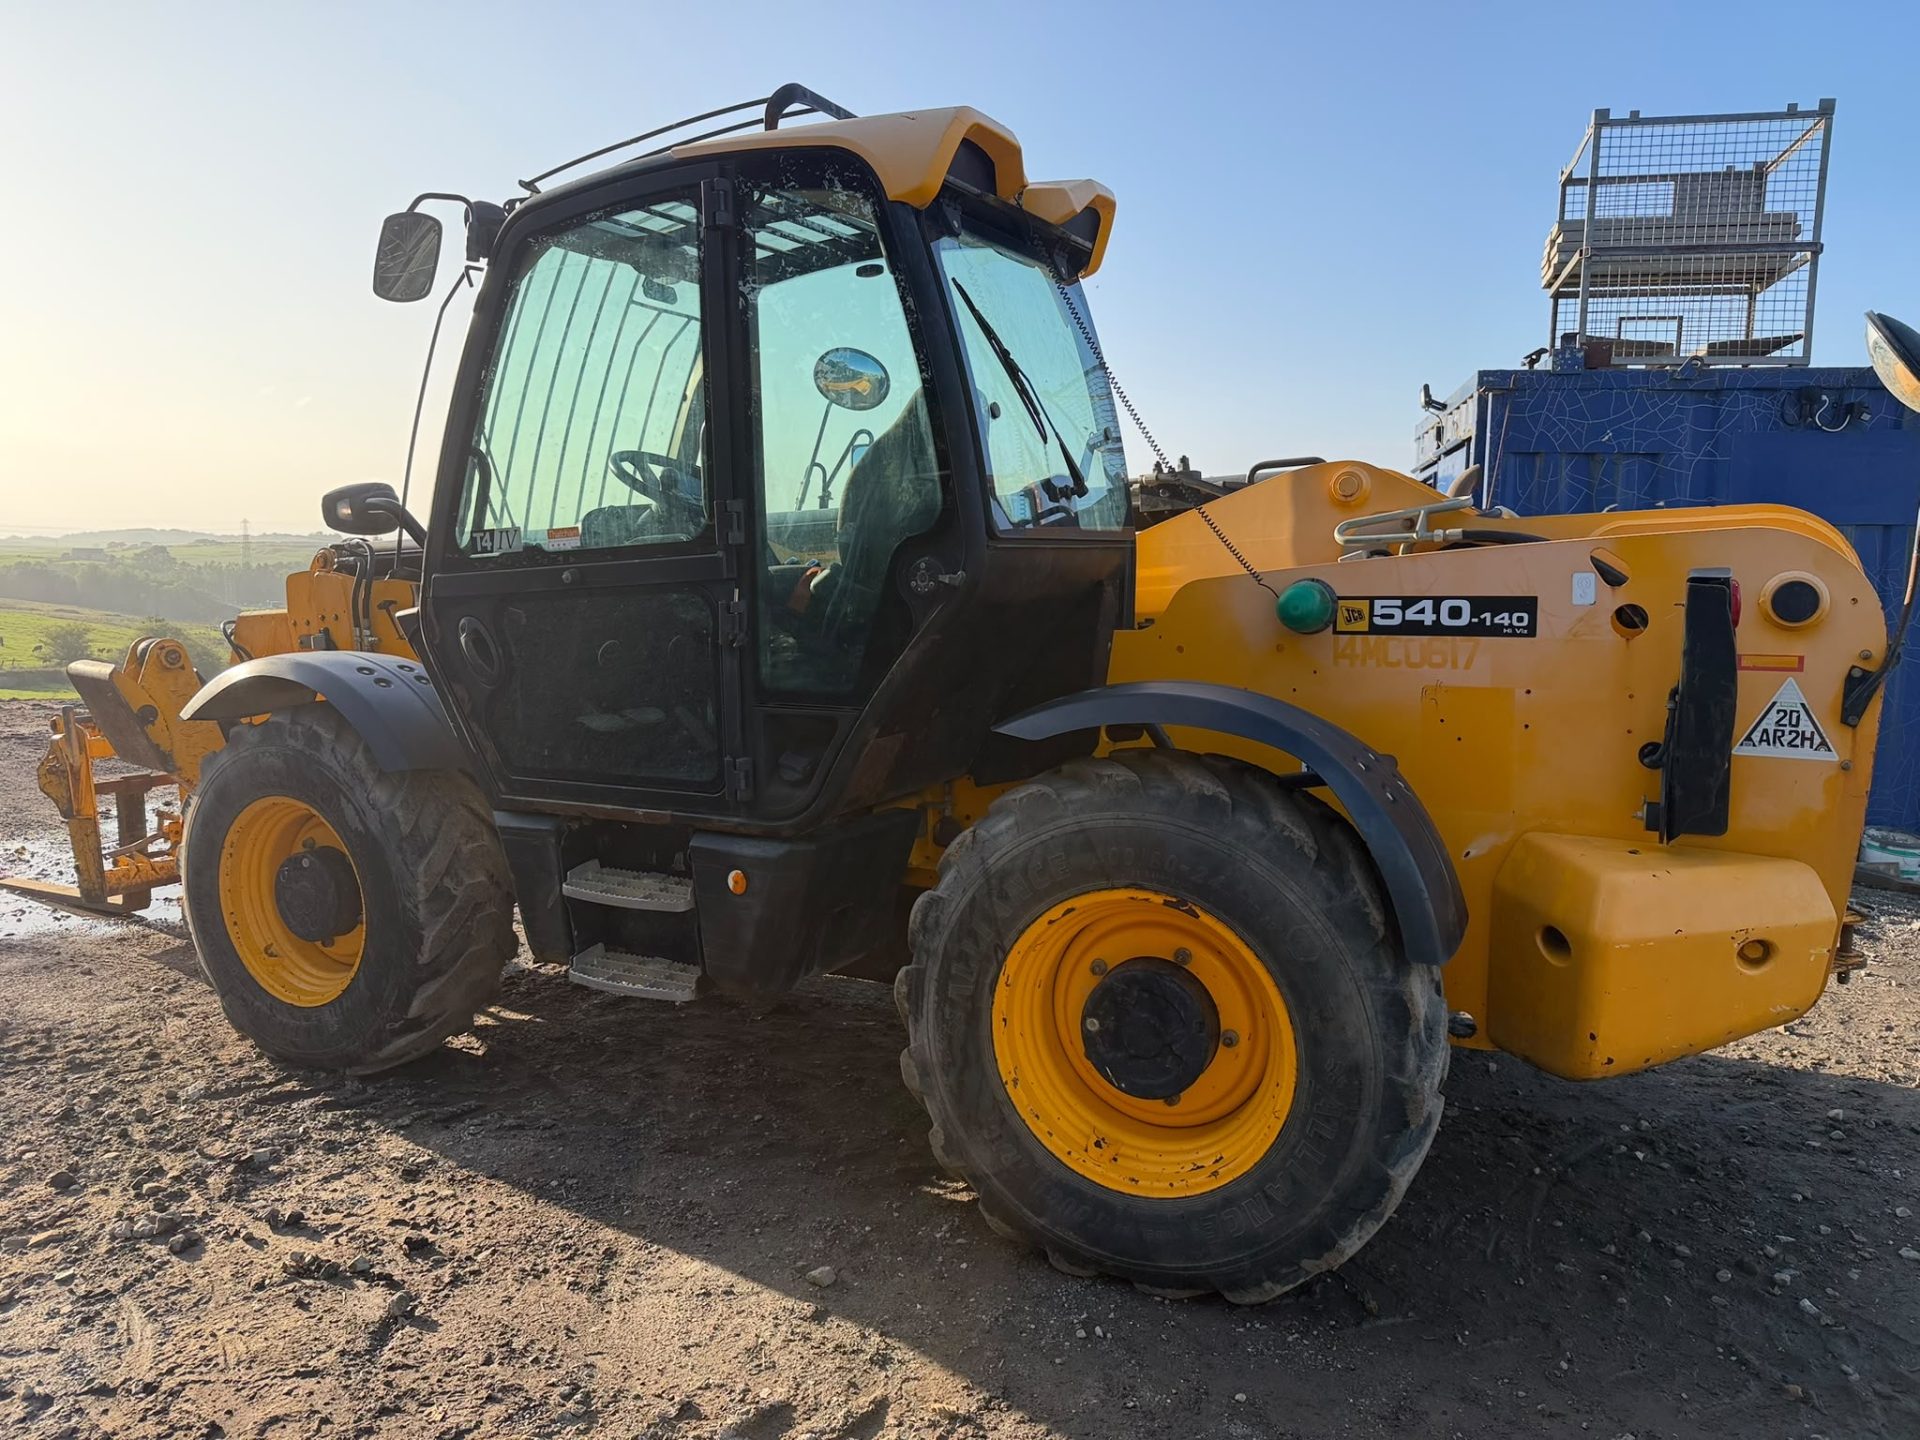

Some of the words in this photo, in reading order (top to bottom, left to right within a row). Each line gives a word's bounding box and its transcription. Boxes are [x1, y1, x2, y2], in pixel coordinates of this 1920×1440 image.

[472, 531, 492, 551] T4
[496, 530, 517, 550] IV
[1342, 606, 1364, 625] JCB
[1758, 728, 1815, 749] AR2H
[1203, 1092, 1343, 1242] ALLIANCE
